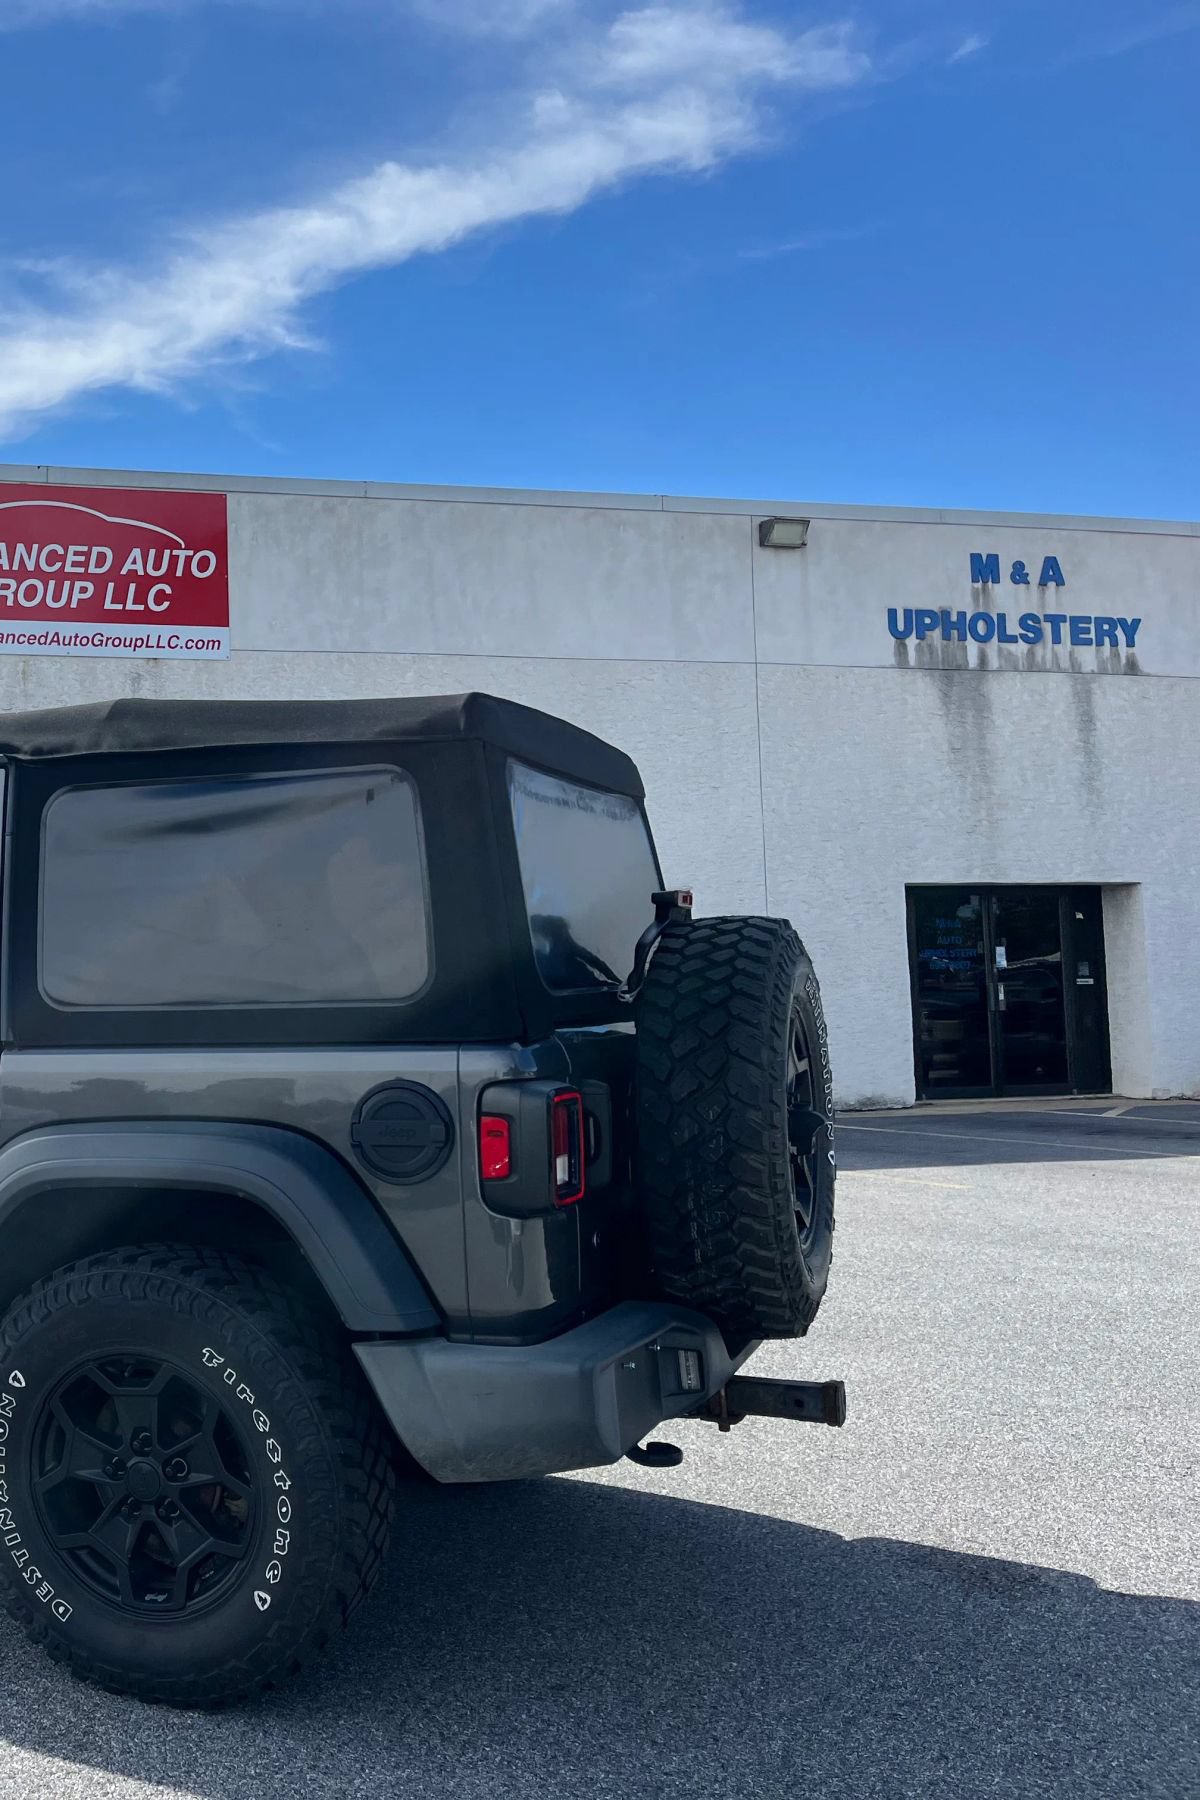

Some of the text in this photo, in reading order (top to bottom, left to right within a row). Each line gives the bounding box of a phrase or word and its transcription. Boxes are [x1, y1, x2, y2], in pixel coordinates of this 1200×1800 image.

[120, 548, 216, 578] AUTO
[969, 553, 1065, 587] M & A
[103, 582, 173, 612] LLC
[887, 608, 1141, 648] UPHOLSTERY
